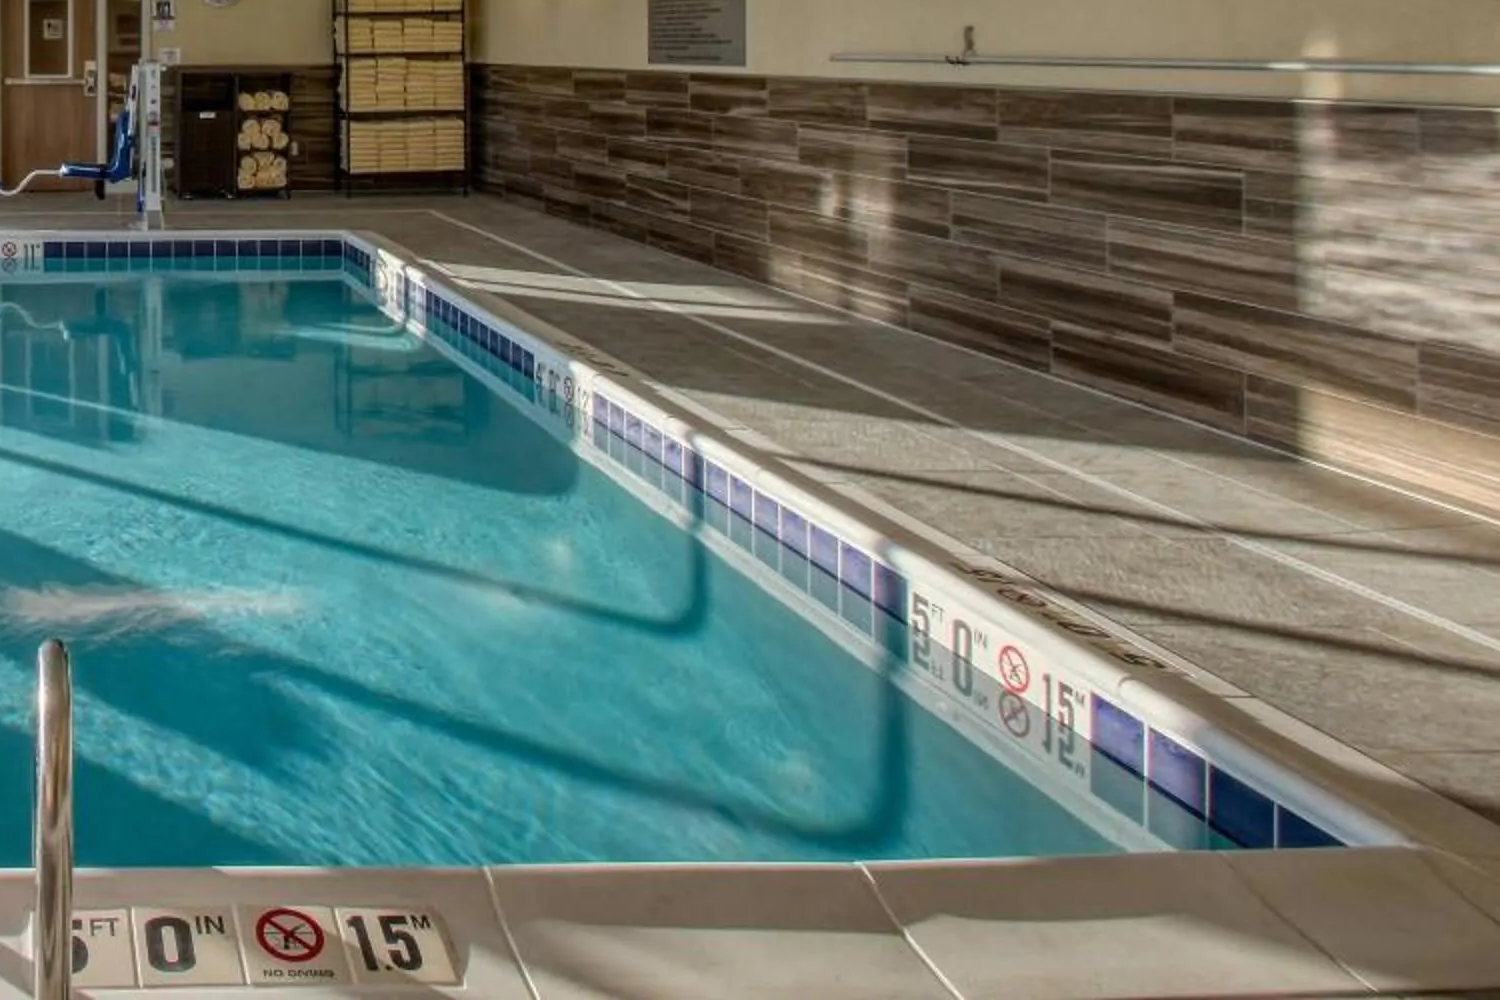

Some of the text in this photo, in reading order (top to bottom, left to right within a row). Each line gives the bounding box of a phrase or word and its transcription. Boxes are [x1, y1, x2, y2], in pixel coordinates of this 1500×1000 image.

[89, 917, 119, 937] FT
[144, 915, 197, 973] 0
[194, 915, 226, 935] IN
[409, 914, 431, 930] M
[263, 968, 283, 978] NO
